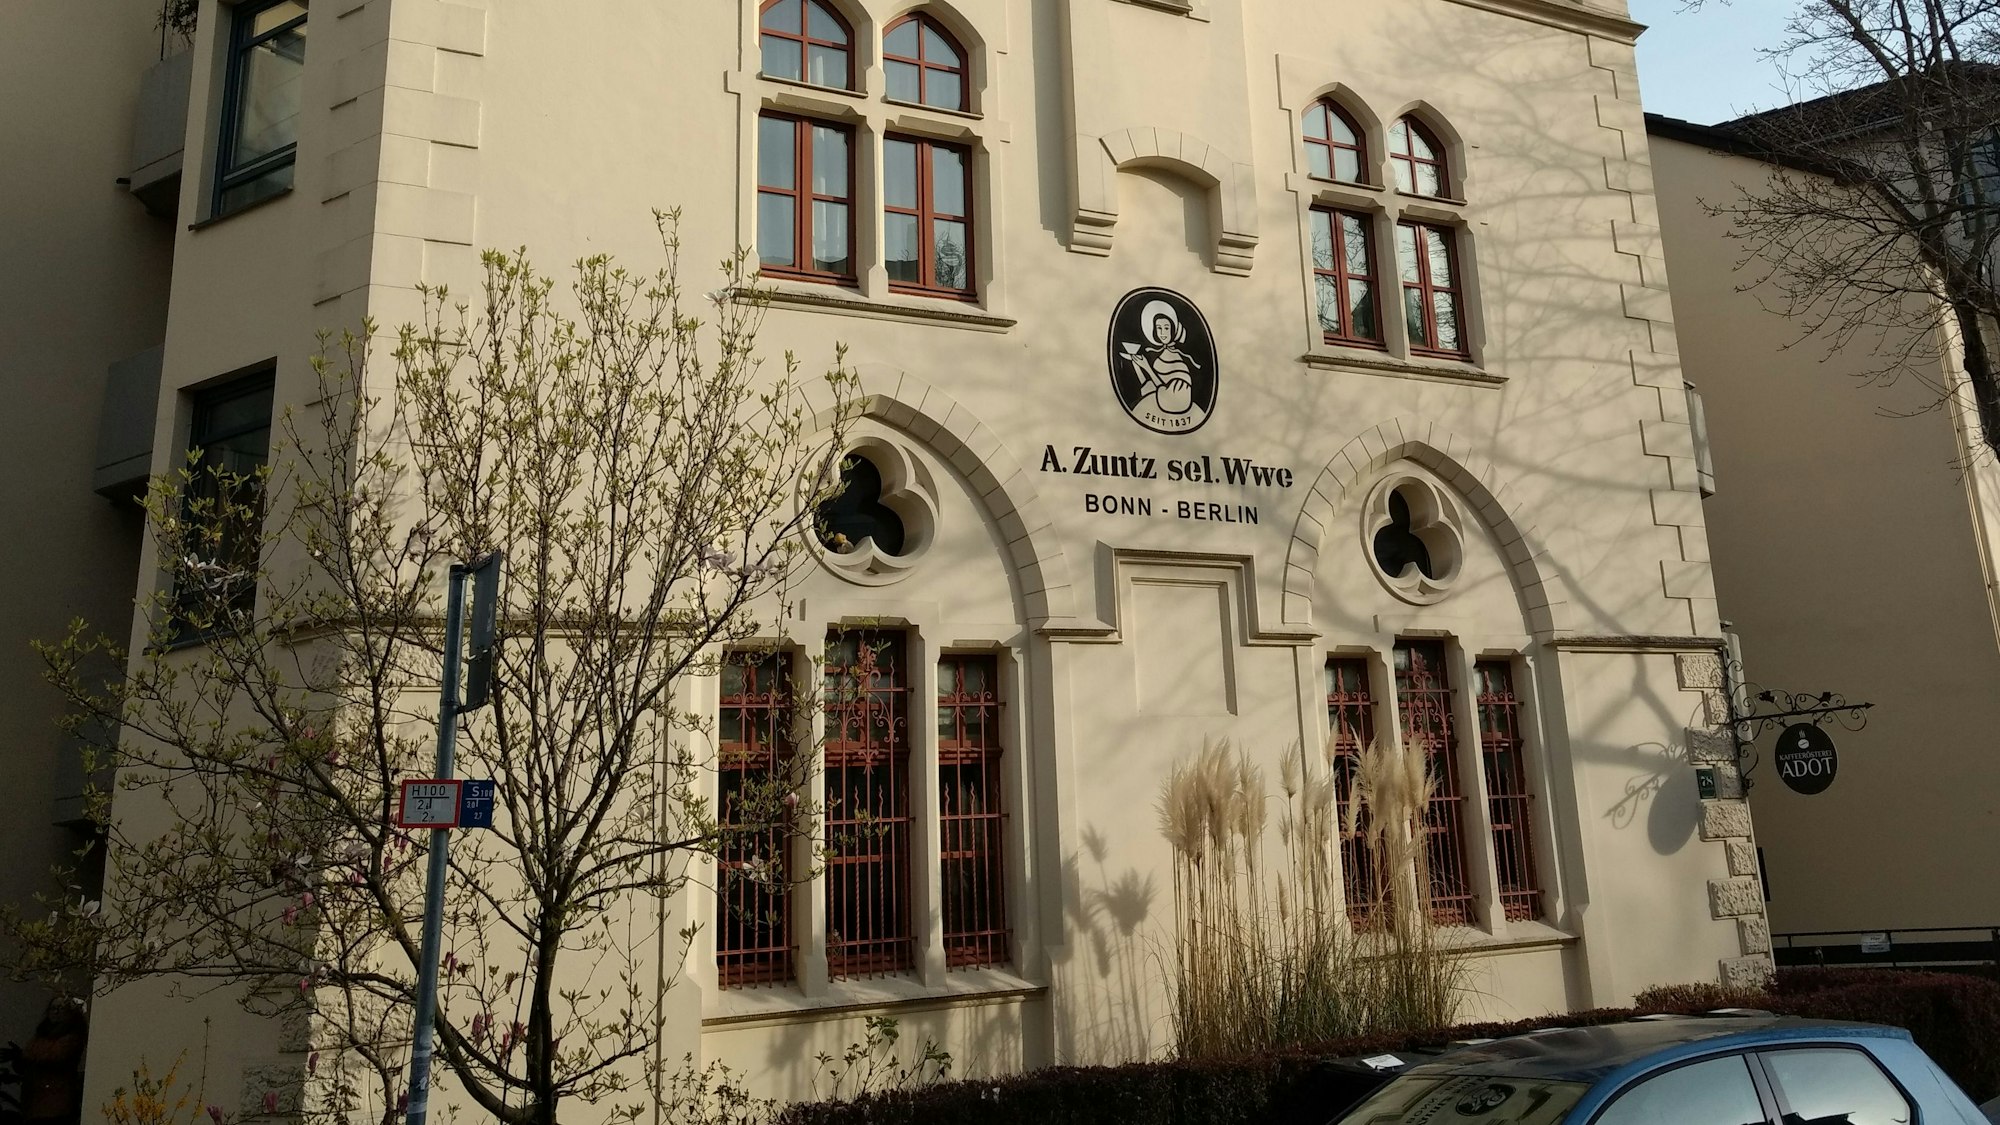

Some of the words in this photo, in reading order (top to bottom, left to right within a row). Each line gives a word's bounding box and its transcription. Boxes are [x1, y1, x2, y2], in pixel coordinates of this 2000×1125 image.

[1145, 413, 1166, 427] SEIT
[1170, 416, 1191, 427] 1837
[1040, 444, 1067, 473] A.
[1073, 446, 1157, 479] Zuntz
[1167, 455, 1219, 483] sel.
[1220, 457, 1293, 488] Wwe
[1085, 494, 1151, 516] BONN
[1178, 501, 1259, 524] BERLIN
[1779, 750, 1832, 761] KAFFEERÖSTEREI
[1781, 757, 1833, 778] ADOT
[1701, 775, 1713, 787] 78
[412, 785, 446, 796] H100
